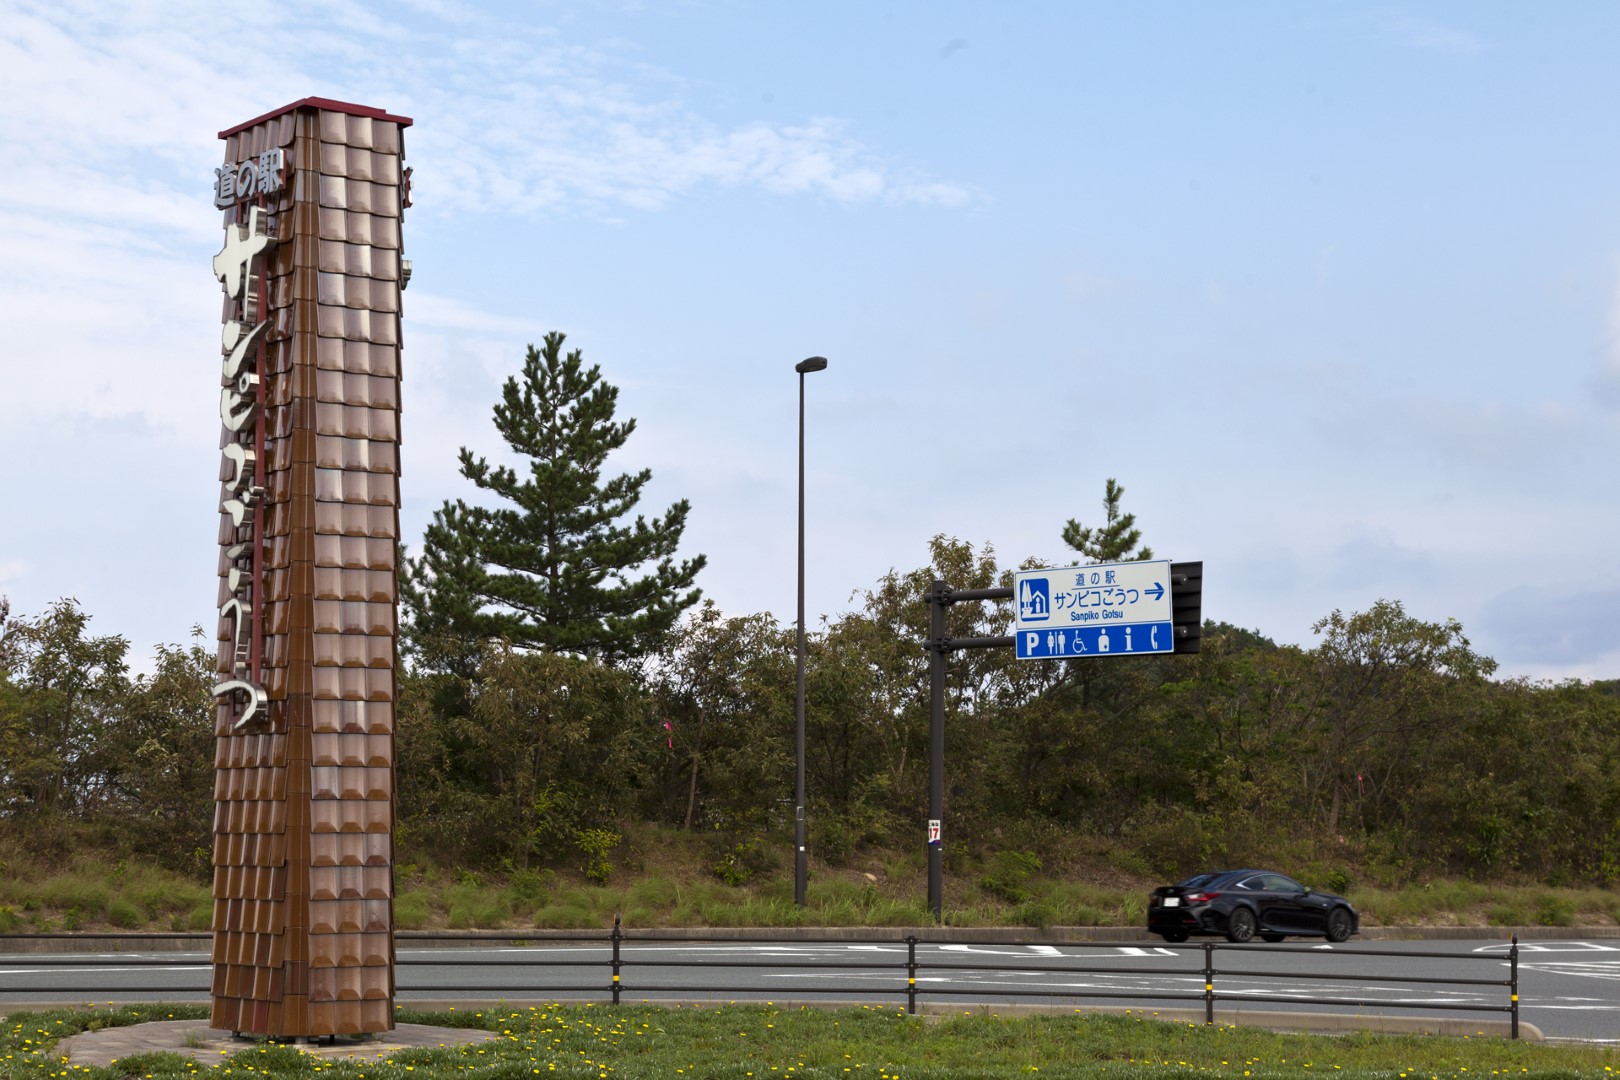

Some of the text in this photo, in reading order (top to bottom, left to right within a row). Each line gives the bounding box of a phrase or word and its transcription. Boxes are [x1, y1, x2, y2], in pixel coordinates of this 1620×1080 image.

[214, 147, 284, 210] 道の駅
[1075, 570, 1116, 586] 道の駅
[1054, 588, 1139, 610] サンピコごうつ
[1070, 609, 1124, 622] Sanpiko Gotsu
[929, 828, 939, 839] 17
